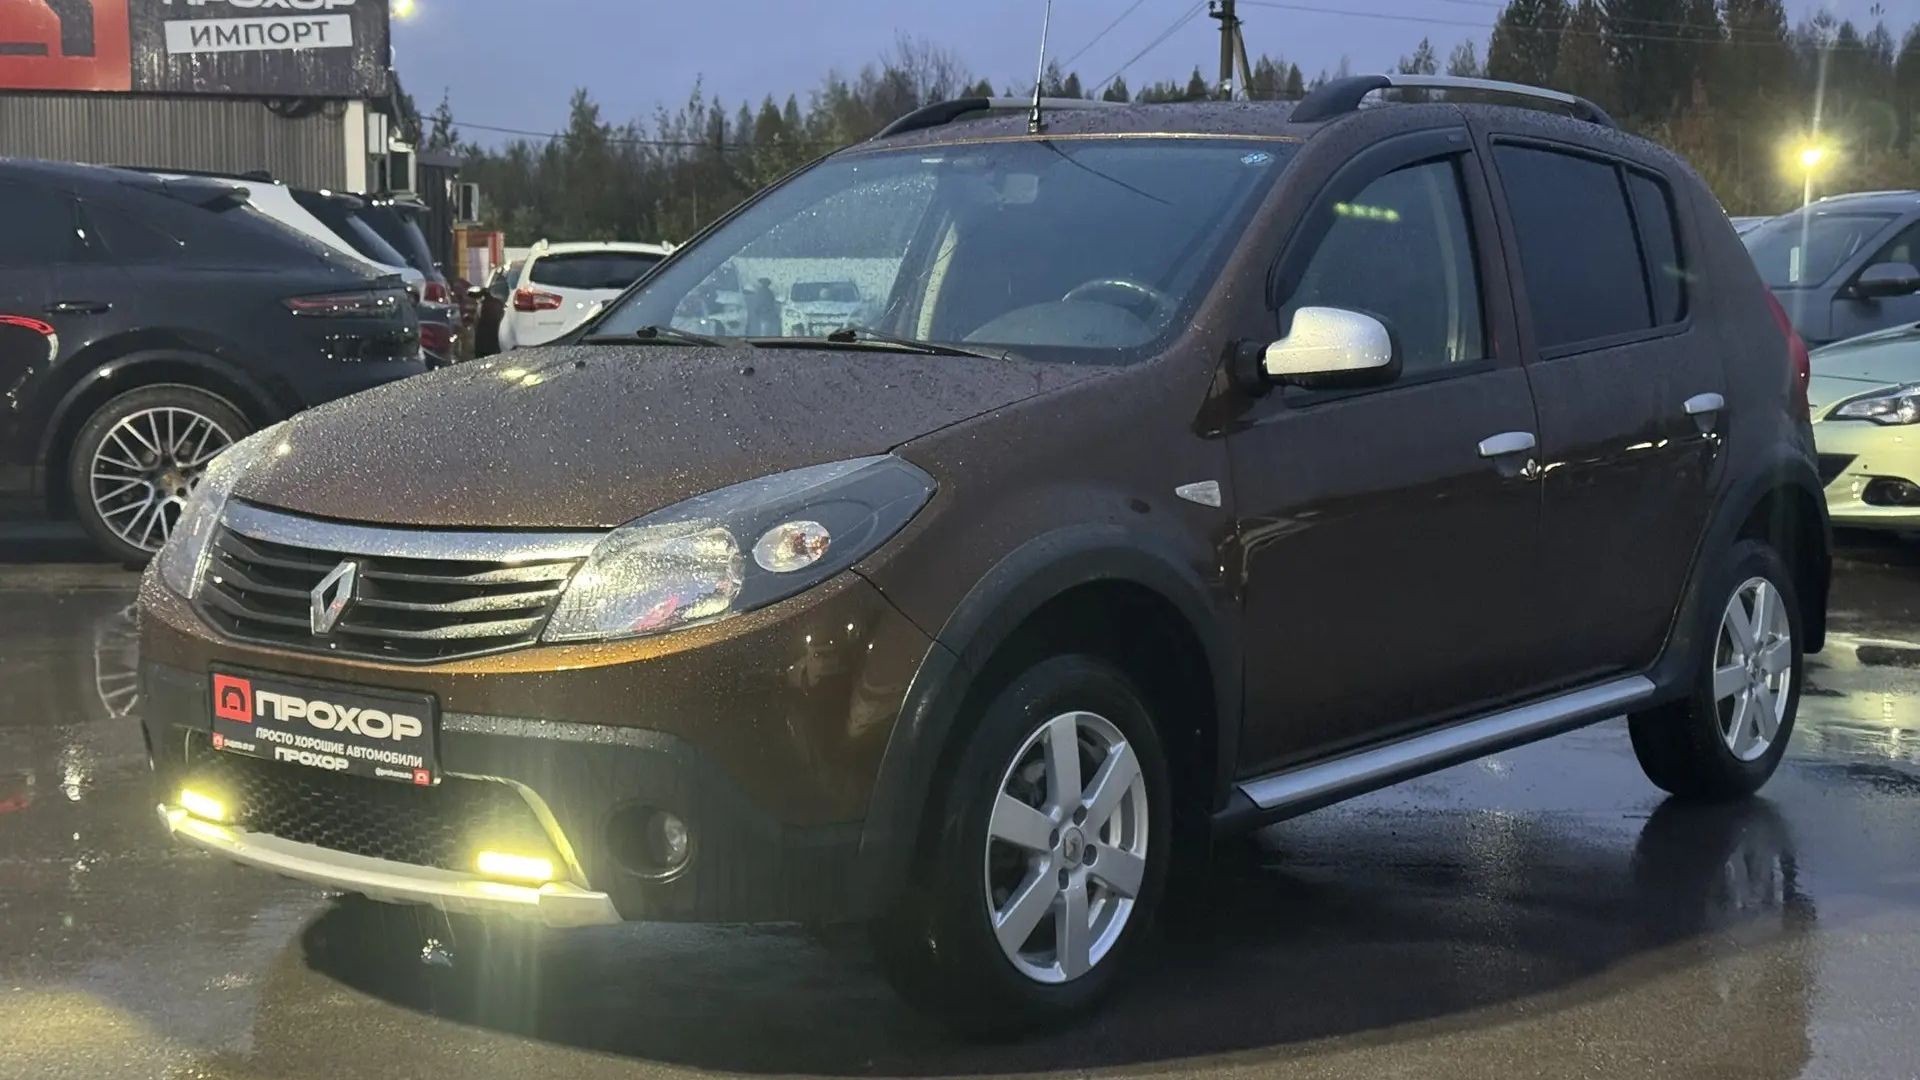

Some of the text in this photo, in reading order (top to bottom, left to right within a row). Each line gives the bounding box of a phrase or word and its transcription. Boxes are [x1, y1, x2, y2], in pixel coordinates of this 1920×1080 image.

[190, 21, 329, 47] ИМПОРТ
[255, 690, 423, 741] ПРОХОР
[255, 727, 293, 745] ПРОСТО
[294, 733, 345, 756] ХОРОШИЕ
[346, 745, 423, 768] АВТОМОБИЛИ
[274, 747, 349, 771] ПРОХОР
